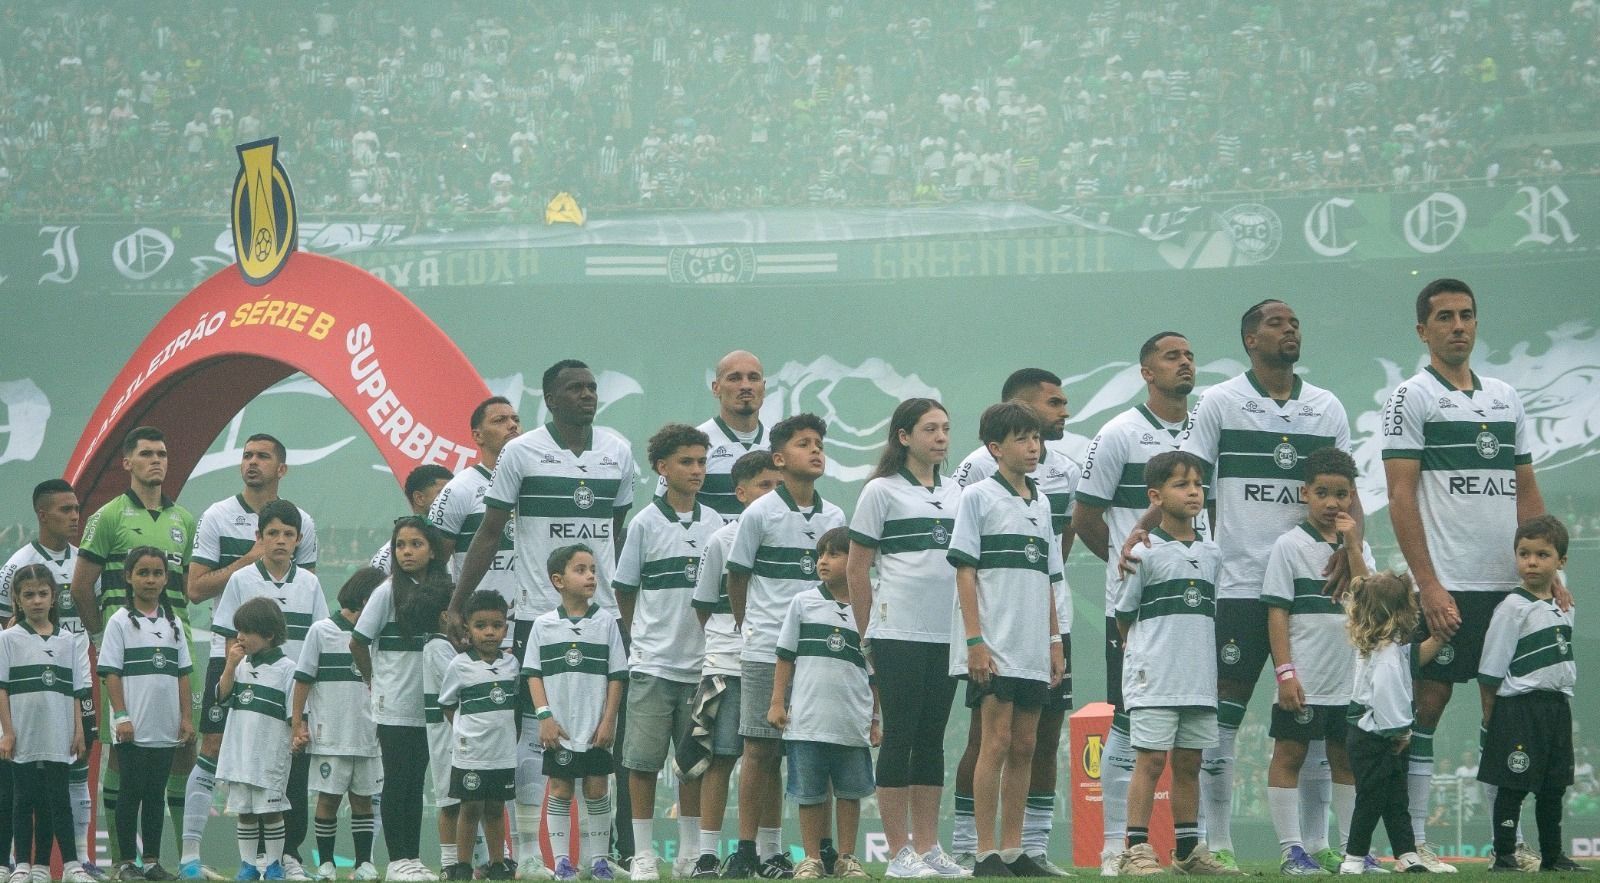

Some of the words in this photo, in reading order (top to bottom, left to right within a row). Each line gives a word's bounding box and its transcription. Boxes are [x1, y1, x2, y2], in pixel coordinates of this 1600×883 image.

[1233, 223, 1267, 240] CFC
[688, 253, 736, 278] CFC
[871, 238, 1007, 279] GREEN
[1016, 235, 1112, 275] HELL
[229, 294, 315, 332] SÉRIE
[307, 311, 337, 341] B
[346, 322, 478, 475] SUPERBET
[1389, 386, 1408, 437] bonus
[1082, 434, 1102, 480] bonus
[1244, 484, 1309, 505] REAL
[1449, 476, 1516, 496] REALS
[435, 487, 452, 527] bonus
[549, 523, 610, 540] REALS
[1, 563, 18, 598] bonus
